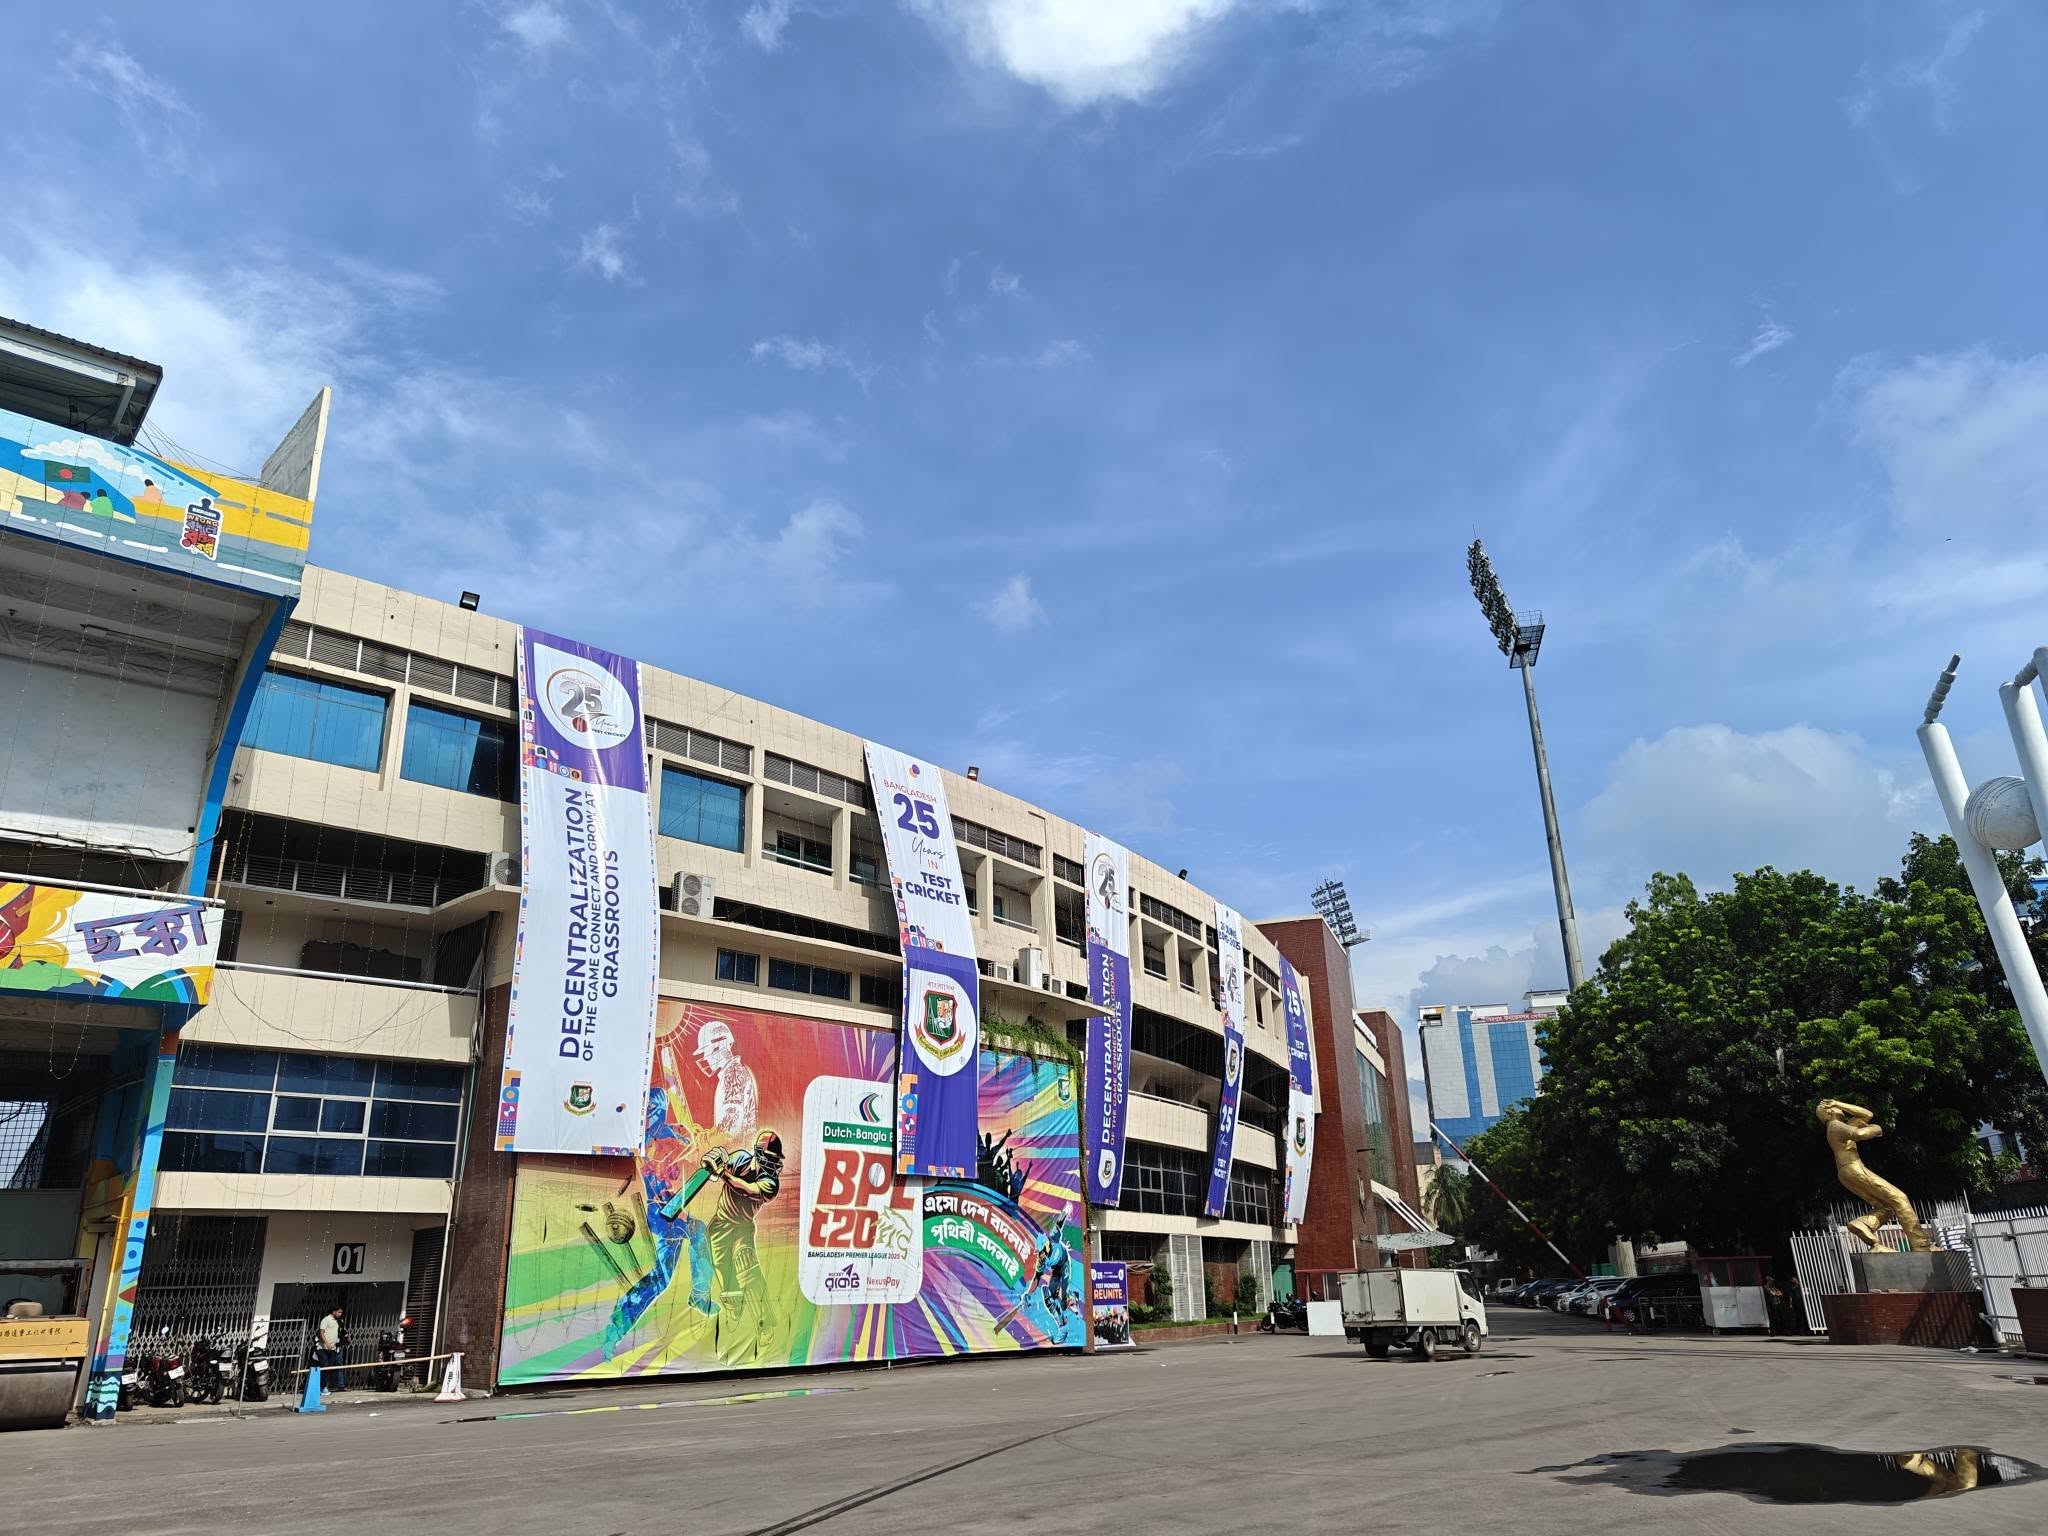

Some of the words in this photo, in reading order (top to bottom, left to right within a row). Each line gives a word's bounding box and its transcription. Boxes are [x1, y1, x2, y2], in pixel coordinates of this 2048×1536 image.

[188, 514, 219, 526] WRONG
[559, 681, 603, 718] 25
[585, 791, 596, 808] AT
[883, 779, 937, 803] BANGLADESH
[586, 810, 598, 851] GROW
[893, 793, 940, 839] 25
[911, 836, 945, 865] Years
[928, 859, 939, 870] IN
[588, 854, 600, 884] AND
[920, 871, 952, 890] TEST
[1098, 864, 1115, 896] 25
[905, 881, 961, 905] CRICKET
[74, 905, 207, 963] ছক্কা
[559, 788, 588, 1058] DECENTRALIZATION
[590, 886, 601, 954] CONNECT
[602, 850, 620, 998] GRASSROOTS
[587, 958, 600, 1002] GAME
[1286, 987, 1301, 1017] 25
[585, 1006, 597, 1036] THE
[582, 1039, 594, 1062] OF
[824, 1126, 887, 1143] Dutch-Bangla
[817, 1149, 915, 1210] BPL
[924, 1196, 959, 1213] এসো
[961, 1199, 989, 1223] দেশ
[991, 1212, 1031, 1263] বদলাই
[337, 1245, 364, 1272] 01
[931, 1218, 975, 1246] পৃথিবী
[977, 1232, 1019, 1280] বদলাই
[866, 1276, 901, 1289] NexusPay
[1093, 1289, 1123, 1300] REUNITE
